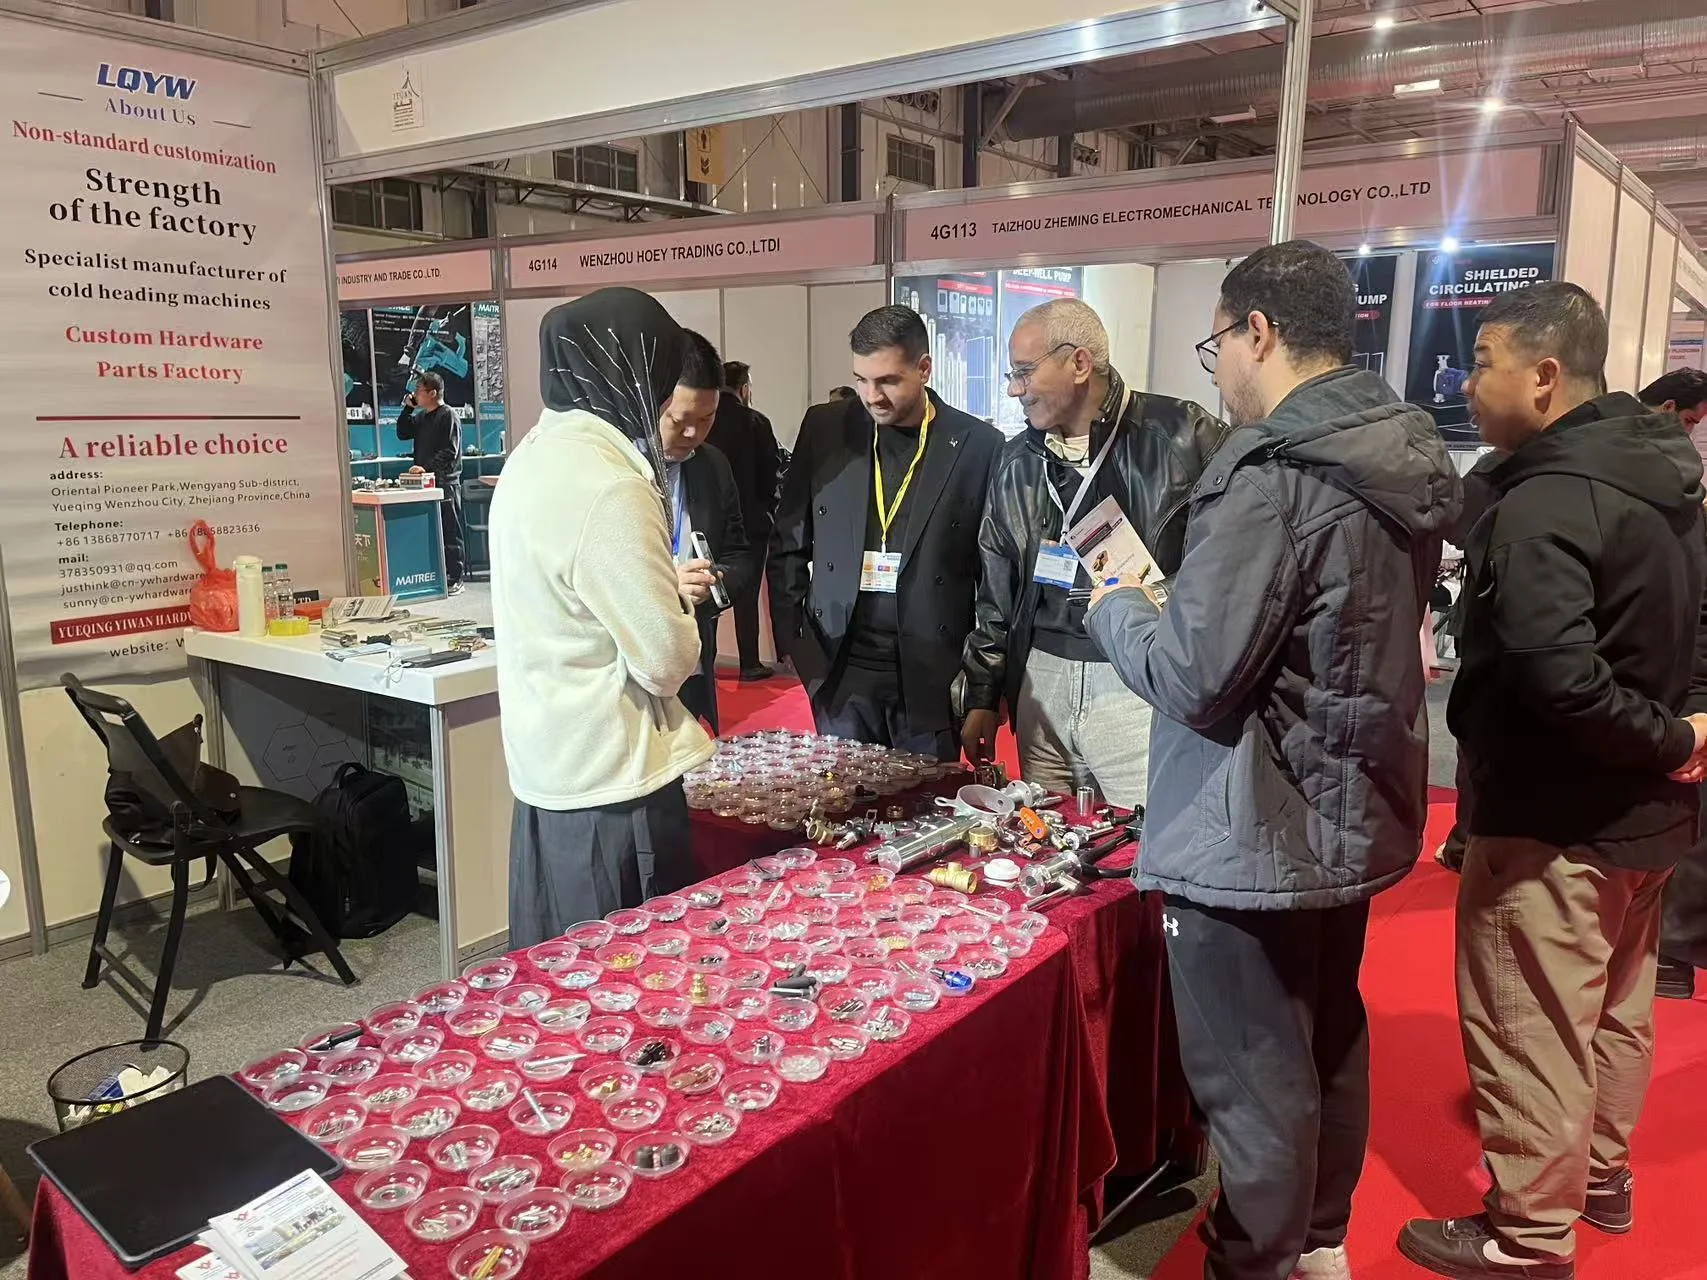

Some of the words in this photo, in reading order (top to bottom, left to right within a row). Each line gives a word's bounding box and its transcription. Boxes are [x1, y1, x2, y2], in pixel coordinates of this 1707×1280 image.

[97, 63, 196, 100] LQYW
[105, 98, 167, 121] About
[172, 109, 196, 126] Us
[12, 120, 149, 154] Non-standard
[154, 142, 277, 174] customization
[86, 168, 222, 208] Strength
[930, 222, 977, 240] 4G113
[992, 219, 1041, 233] TAIZHOU
[1044, 213, 1099, 229] ZHEMING
[1103, 199, 1253, 224] ELECTROMECHANICAL
[1257, 187, 1363, 210] TENOLOGY
[1367, 181, 1431, 200] CO.,LTD
[49, 198, 84, 222] of
[91, 201, 141, 227] the
[150, 207, 257, 246] factory
[24, 248, 129, 271] Specialist
[133, 259, 266, 282] manufacturer
[269, 269, 287, 283] of
[528, 258, 558, 272] 4G114
[579, 251, 634, 268] WENZHOU
[637, 248, 668, 263] HOEY
[671, 243, 723, 261] TRADING
[341, 274, 372, 285] INDUSTRY
[374, 272, 388, 282] AND
[389, 270, 411, 280] TRADE
[1464, 267, 1539, 281] SHIELDED
[49, 282, 93, 298] cold
[99, 284, 179, 307] heading
[184, 291, 271, 310] machines
[1355, 294, 1387, 305] UMP
[66, 325, 153, 345] Custom
[159, 330, 264, 350] Hardware
[97, 361, 158, 378] Parts
[163, 362, 244, 384] Factory
[59, 437, 80, 459] A
[87, 433, 199, 458] reliable
[204, 433, 289, 454] choice
[50, 470, 104, 480] address:
[51, 485, 101, 497] Oriental
[104, 484, 149, 494] Pioneer
[52, 501, 102, 513] Yueqing
[105, 499, 159, 509] Wenzhou
[189, 495, 235, 506] Zhejiang
[54, 520, 123, 532] Telephone:
[57, 536, 80, 547] +86
[84, 530, 160, 545] 13868770717
[168, 528, 188, 539] +86
[58, 553, 89, 564] mail:
[59, 560, 178, 579] 378350931@qq.com
[396, 572, 437, 587] MAITREE
[63, 588, 193, 609] sunny@cn-ywhardwar
[58, 621, 113, 639] YUEQING
[115, 616, 153, 631] YIWAN
[109, 641, 169, 658] website:
